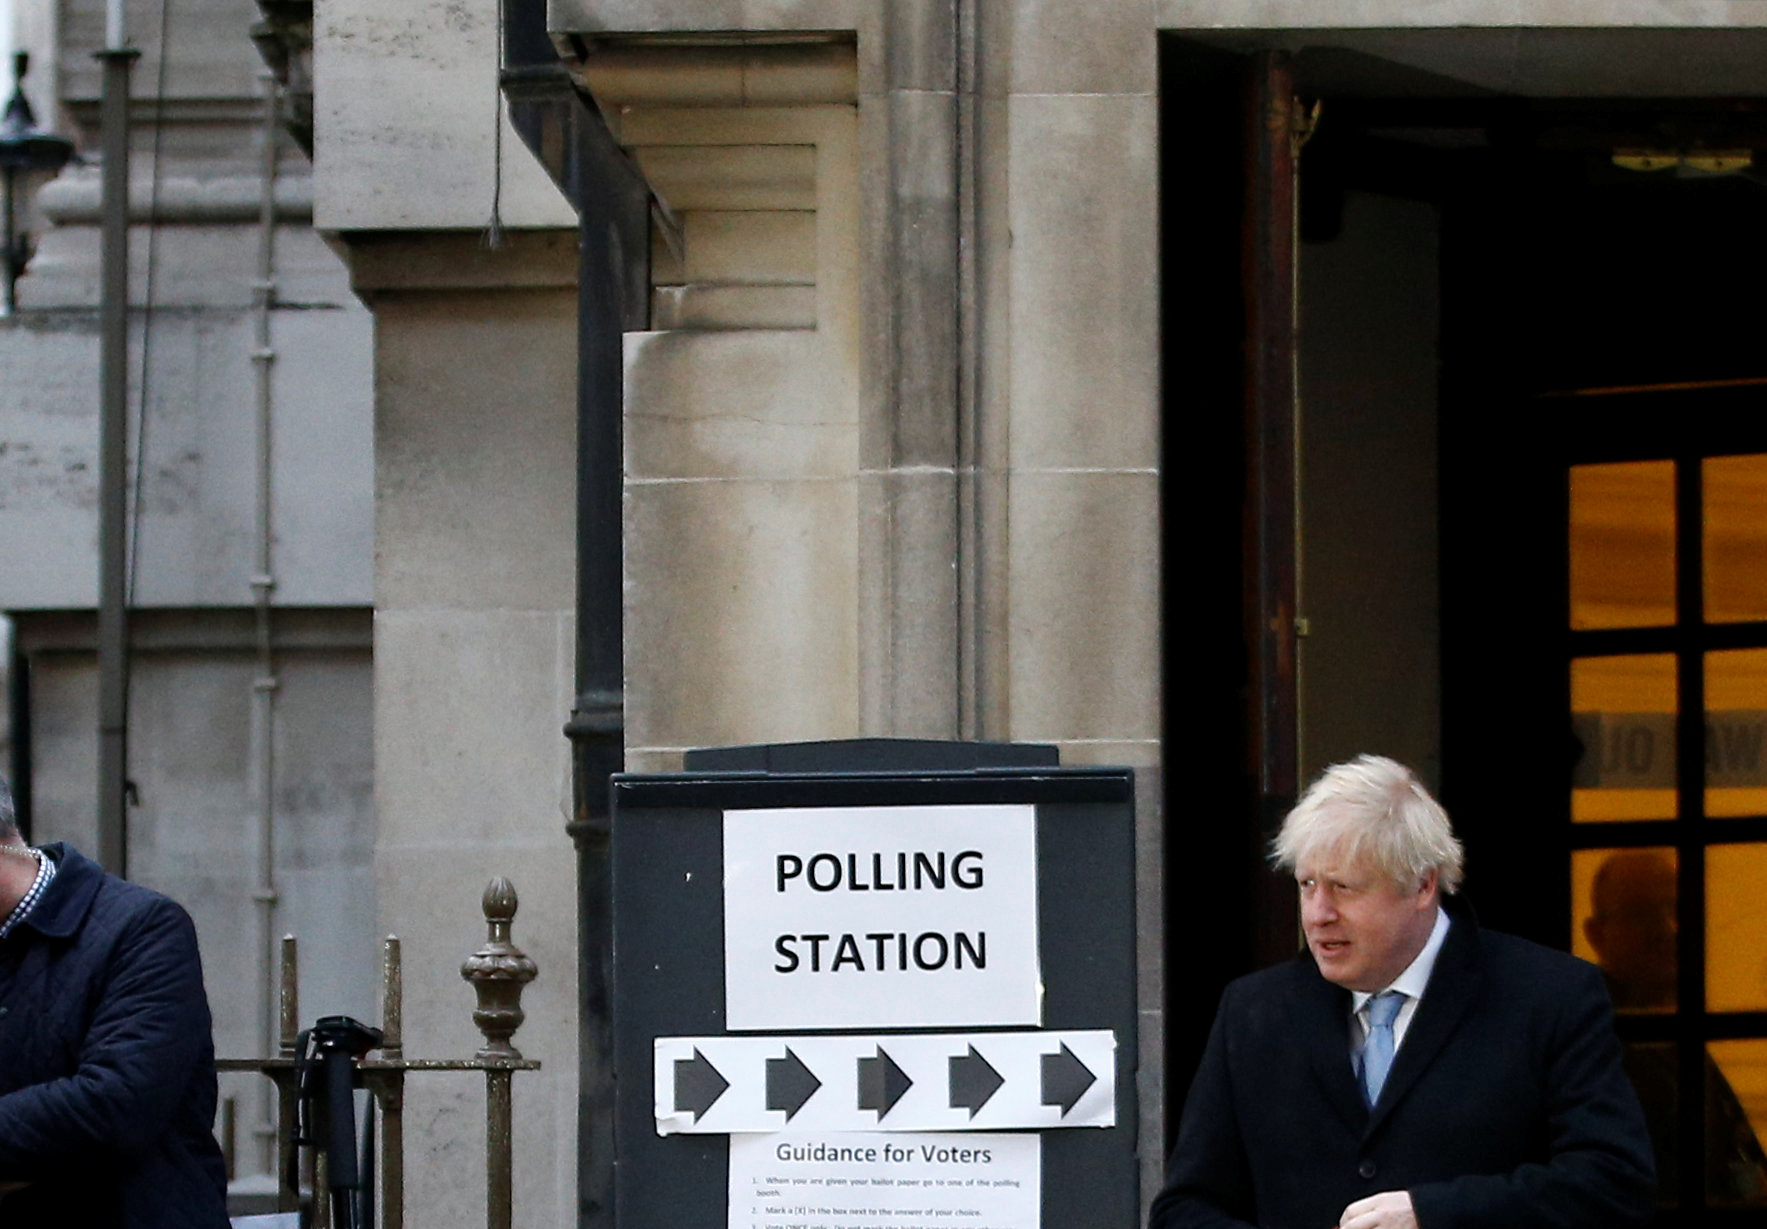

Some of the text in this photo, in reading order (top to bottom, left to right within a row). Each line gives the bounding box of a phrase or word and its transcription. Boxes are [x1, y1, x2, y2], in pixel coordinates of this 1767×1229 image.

[776, 849, 985, 892] POLLING
[773, 931, 988, 973] STATION
[775, 1142, 992, 1164] Guidance for Voters
